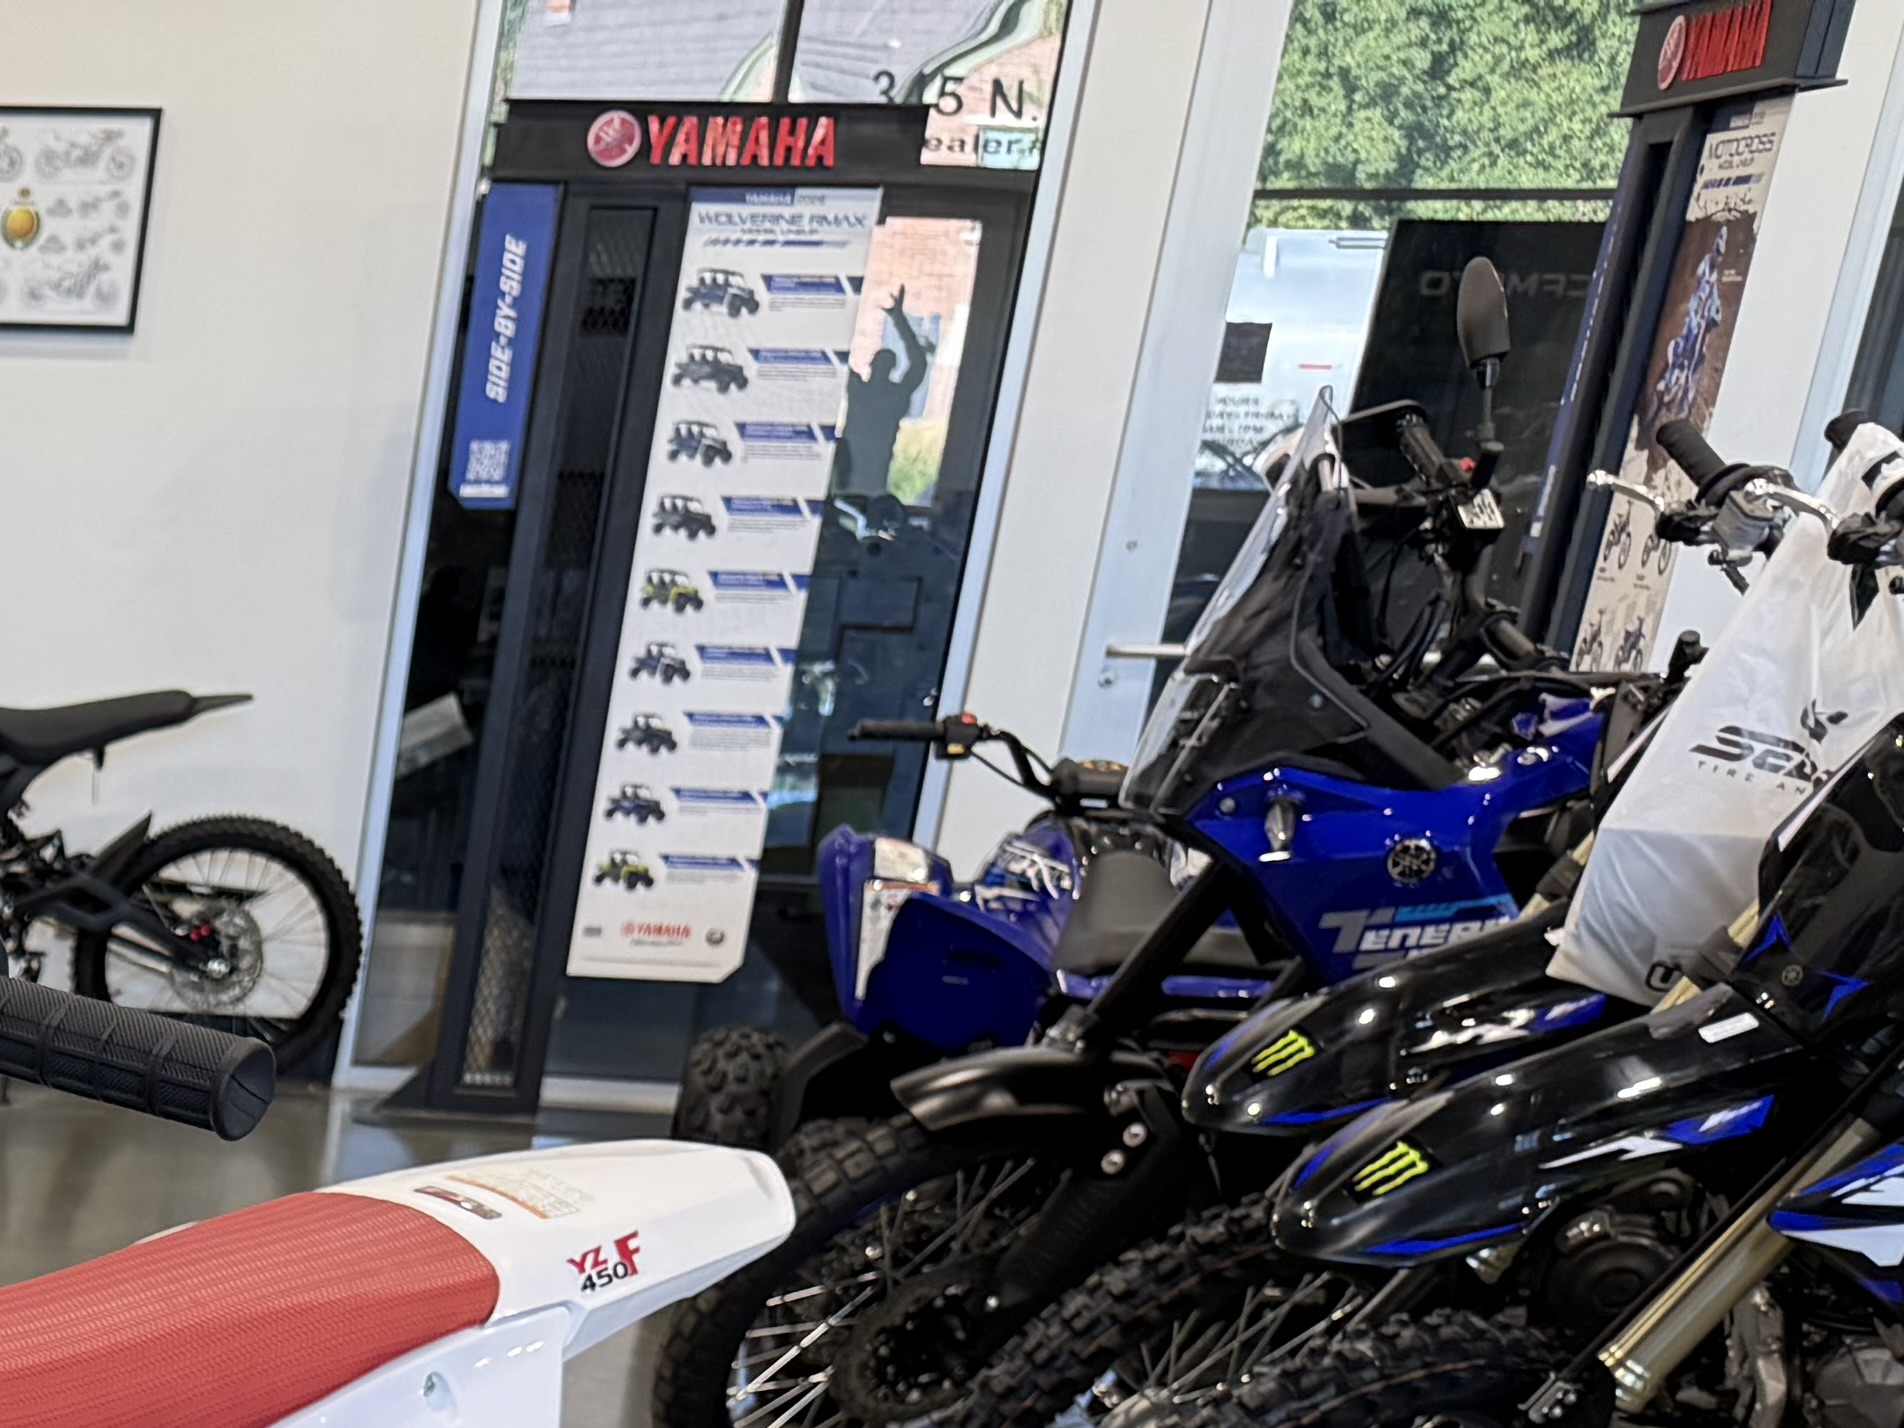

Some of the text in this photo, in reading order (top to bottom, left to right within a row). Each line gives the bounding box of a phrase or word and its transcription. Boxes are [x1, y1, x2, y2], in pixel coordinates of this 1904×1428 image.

[990, 78, 1039, 122] N.
[648, 115, 835, 168] YAMAHA
[698, 210, 867, 228] WOLVERINE RMAX
[485, 233, 527, 404] SIDE-BY-SIDE
[1697, 760, 1807, 796] TIRE AN
[580, 1261, 629, 1293] 450
